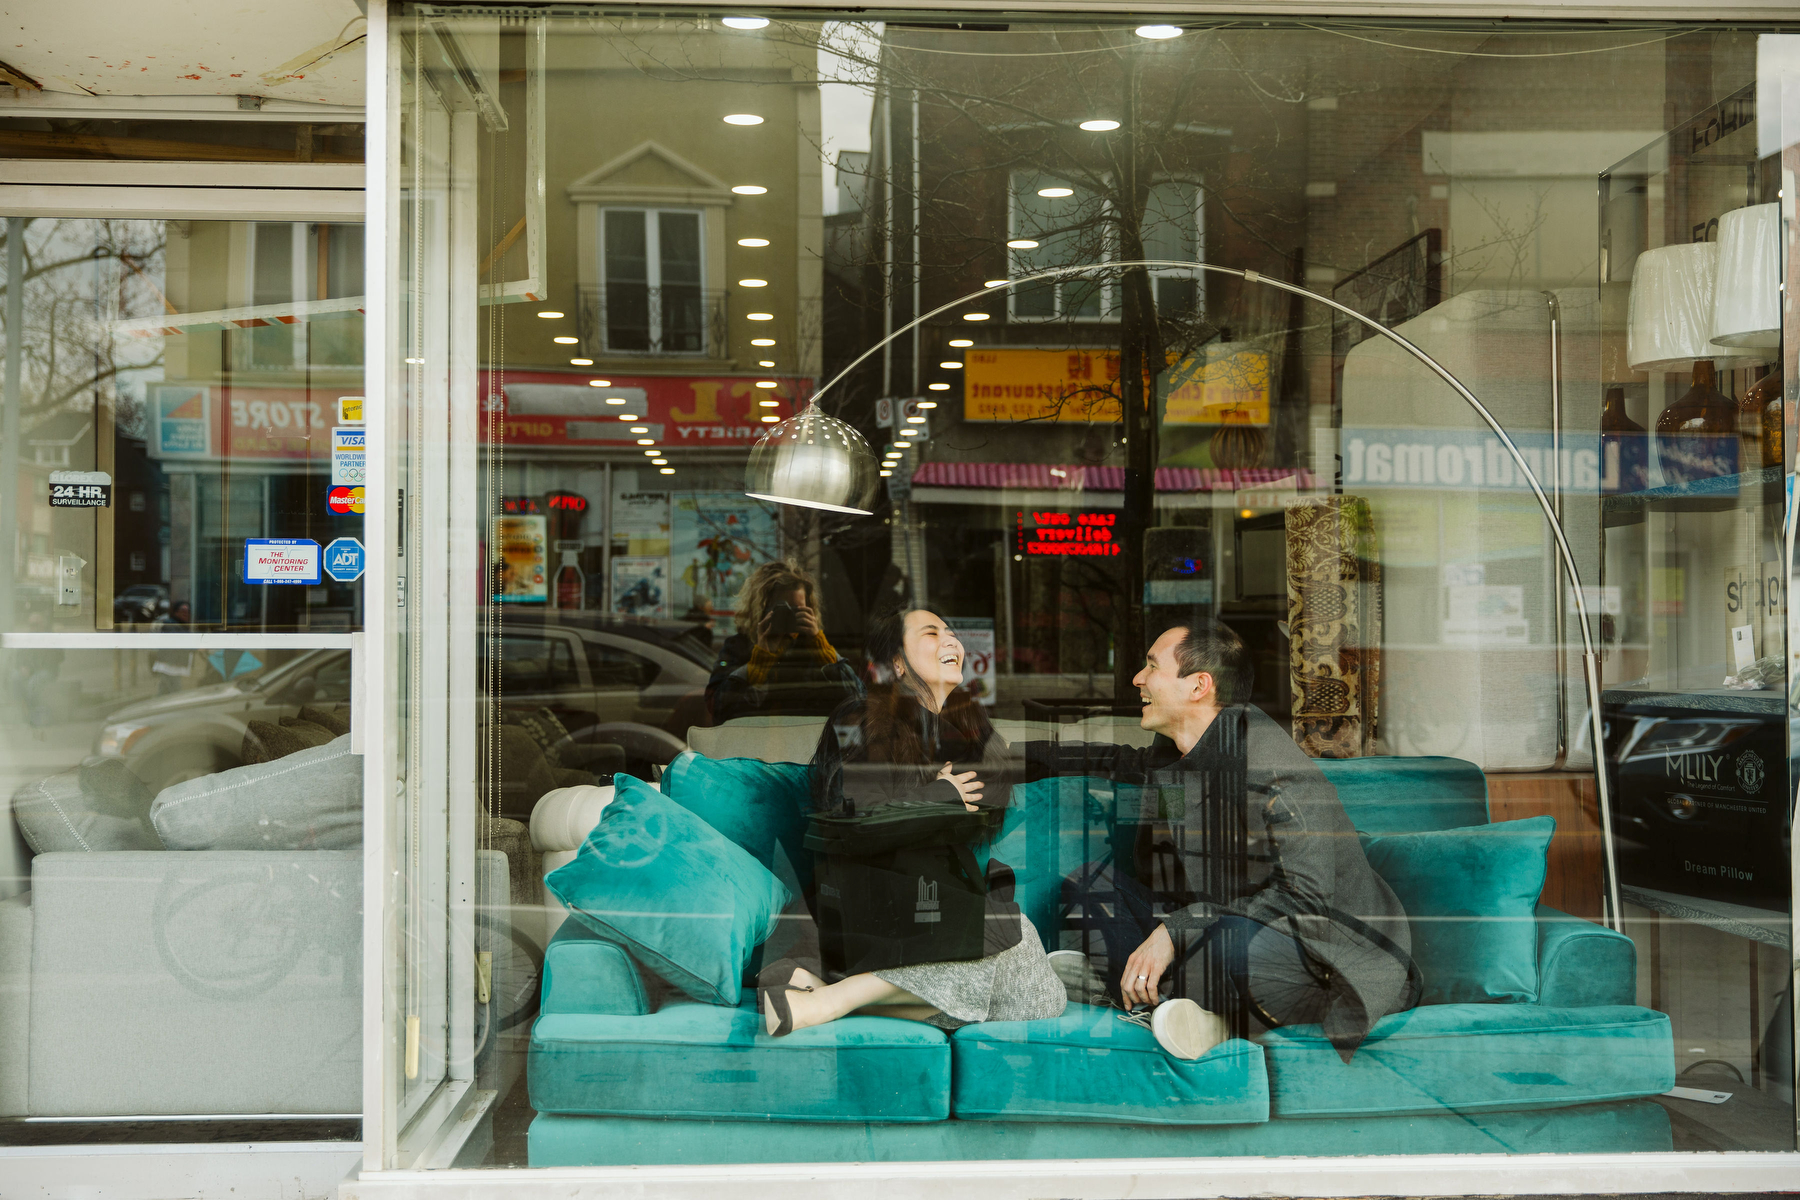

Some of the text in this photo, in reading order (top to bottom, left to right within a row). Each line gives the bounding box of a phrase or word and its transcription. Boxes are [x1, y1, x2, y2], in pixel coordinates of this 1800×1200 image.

[341, 436, 365, 446] VISA
[53, 485, 107, 499] 24 HR.
[52, 498, 107, 506] SURVEILLANCE
[329, 495, 366, 505] MasterCa
[258, 557, 309, 565] MONITORING
[332, 552, 359, 566] ADT
[273, 565, 305, 573] CENTER
[1714, 803, 1748, 813] MANCHESTER
[1748, 806, 1767, 815] UNITED
[1684, 860, 1754, 881] Dream Pillow
